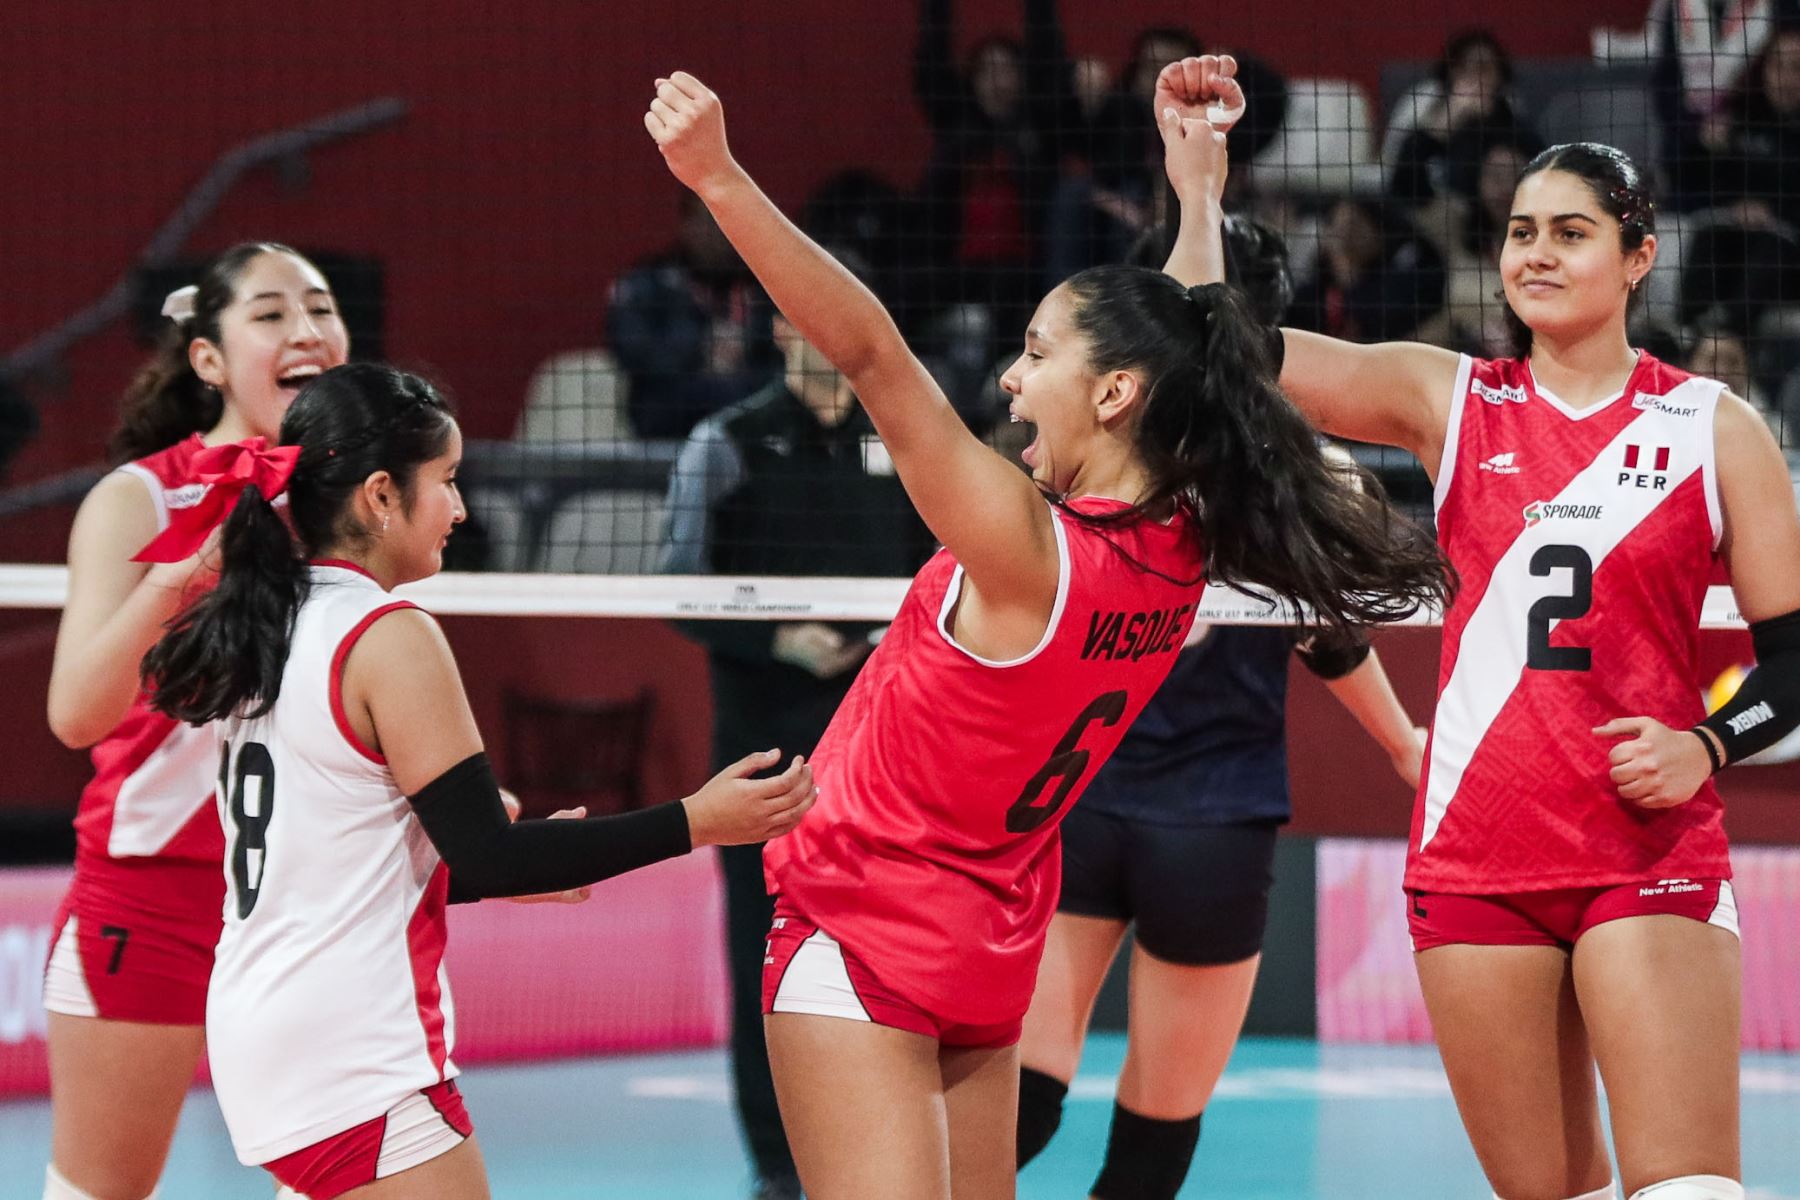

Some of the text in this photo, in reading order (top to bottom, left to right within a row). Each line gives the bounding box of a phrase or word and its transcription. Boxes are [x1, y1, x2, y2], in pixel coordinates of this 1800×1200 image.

[1634, 396, 1699, 417] JetSMART
[1617, 472, 1667, 490] PER
[1542, 504, 1603, 519] SPORADE
[1527, 544, 1593, 672] 2
[1080, 603, 1193, 662] VASQUE
[1005, 689, 1128, 833] 6
[1639, 887, 1665, 896] New
[101, 925, 129, 976] 7
